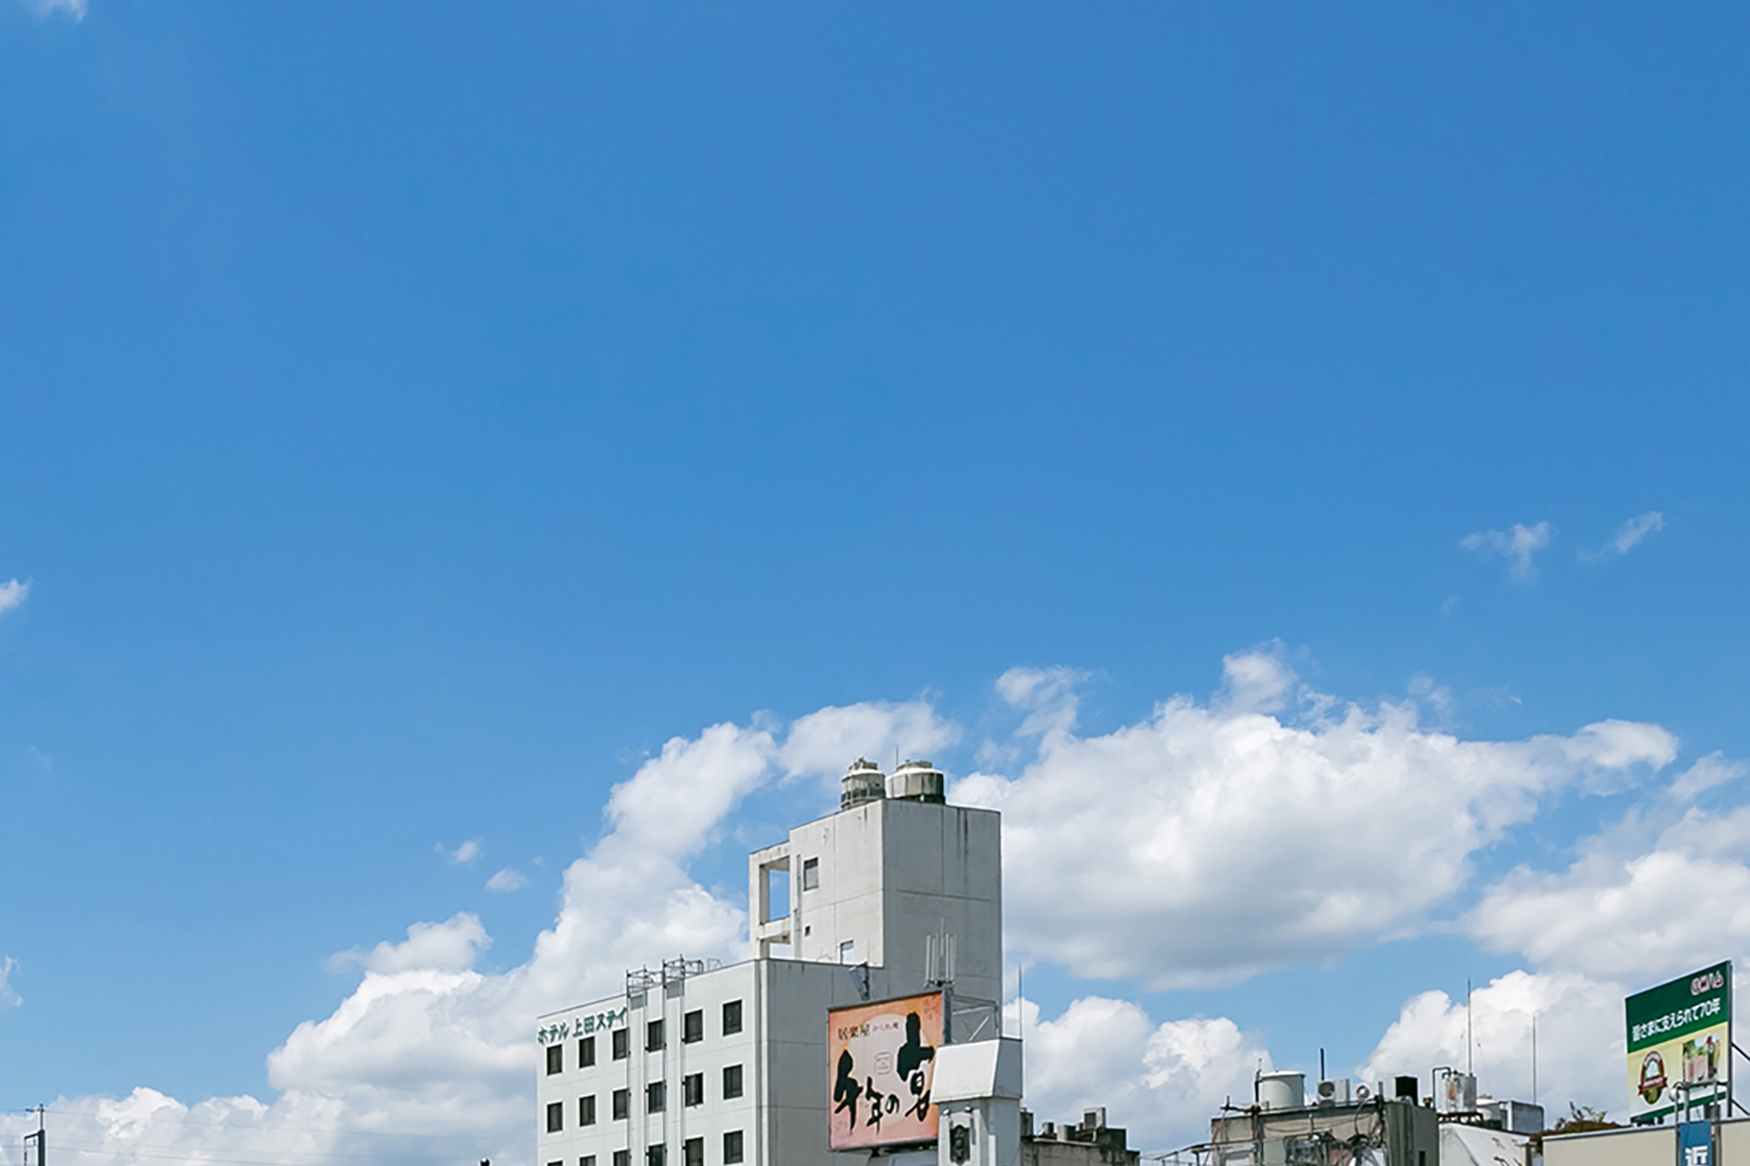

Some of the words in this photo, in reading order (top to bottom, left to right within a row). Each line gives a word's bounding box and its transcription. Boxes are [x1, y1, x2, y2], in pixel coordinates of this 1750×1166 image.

[537, 1022, 570, 1044] ホテル
[572, 1007, 628, 1038] 上田ステイ
